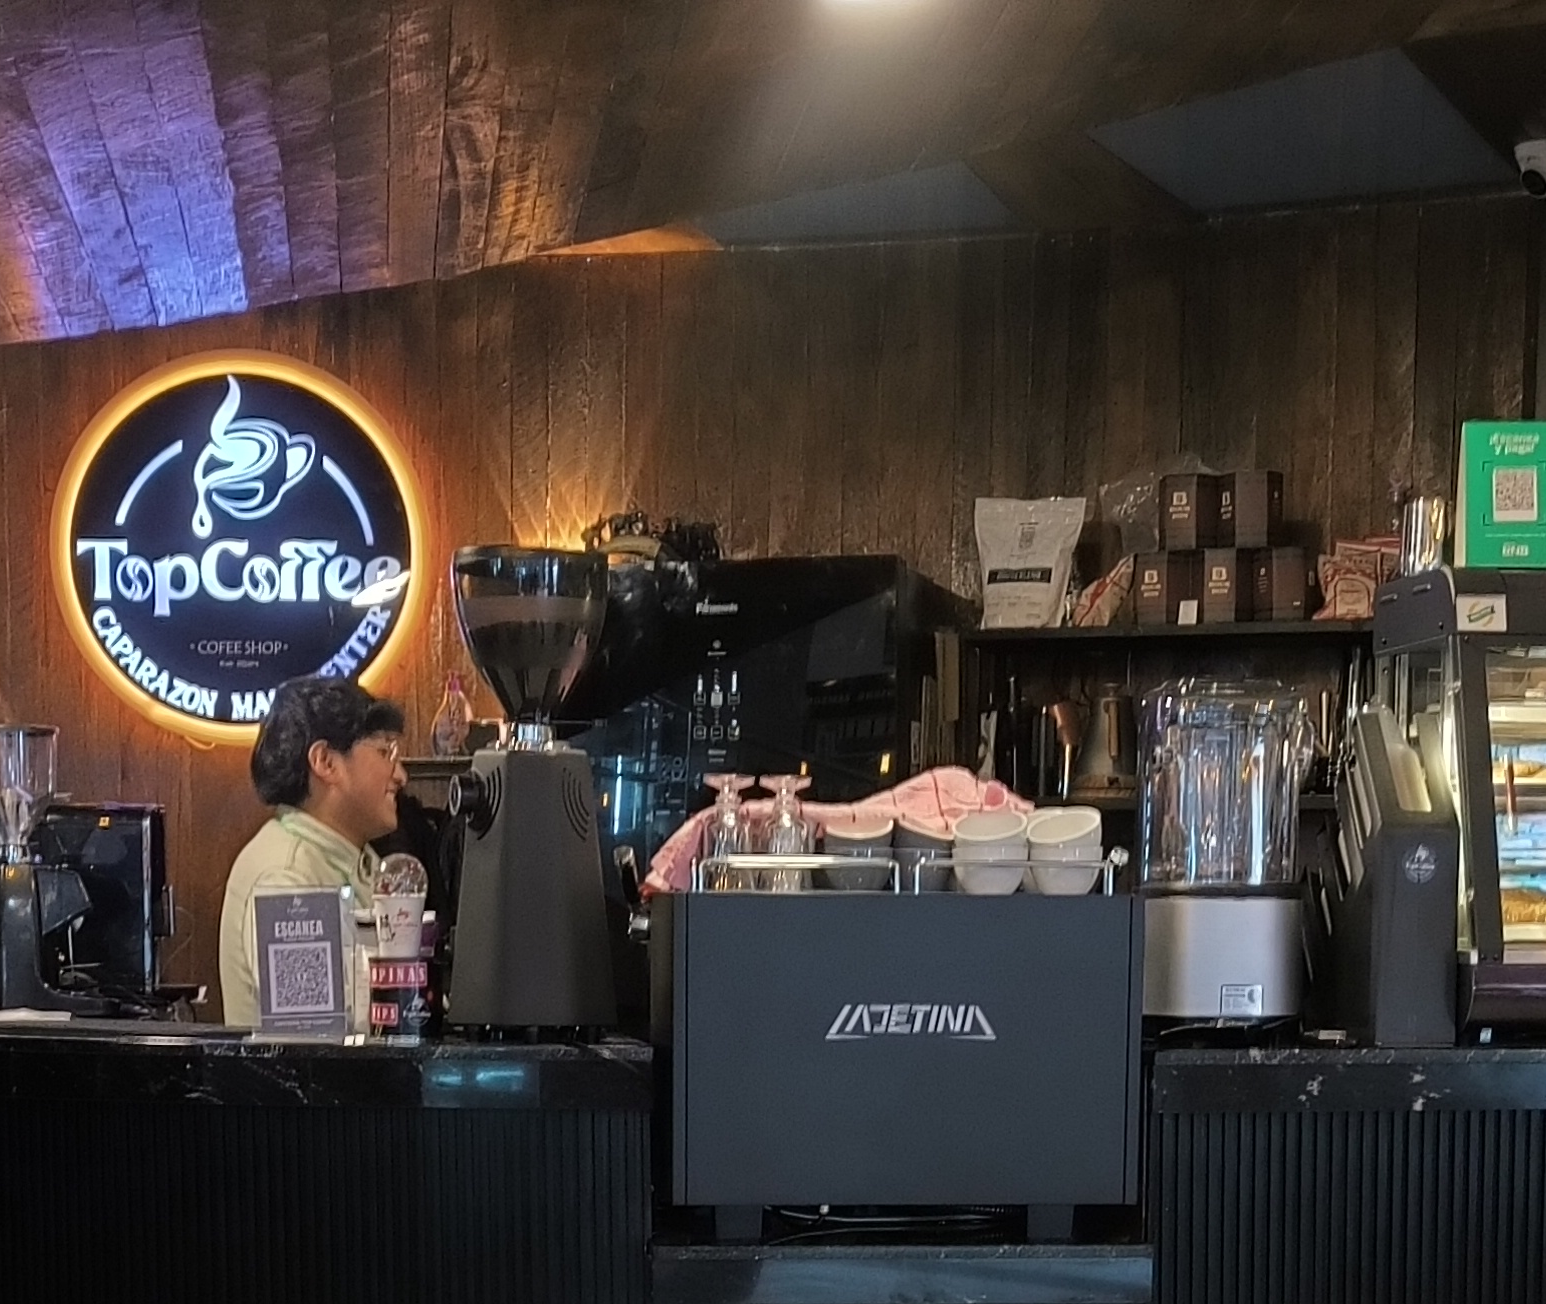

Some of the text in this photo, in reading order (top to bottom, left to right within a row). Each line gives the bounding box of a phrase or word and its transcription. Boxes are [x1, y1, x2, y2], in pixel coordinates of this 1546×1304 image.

[77, 538, 402, 617] TopCoffee
[92, 605, 219, 719] CAPARAZON
[244, 640, 282, 655] SHOP
